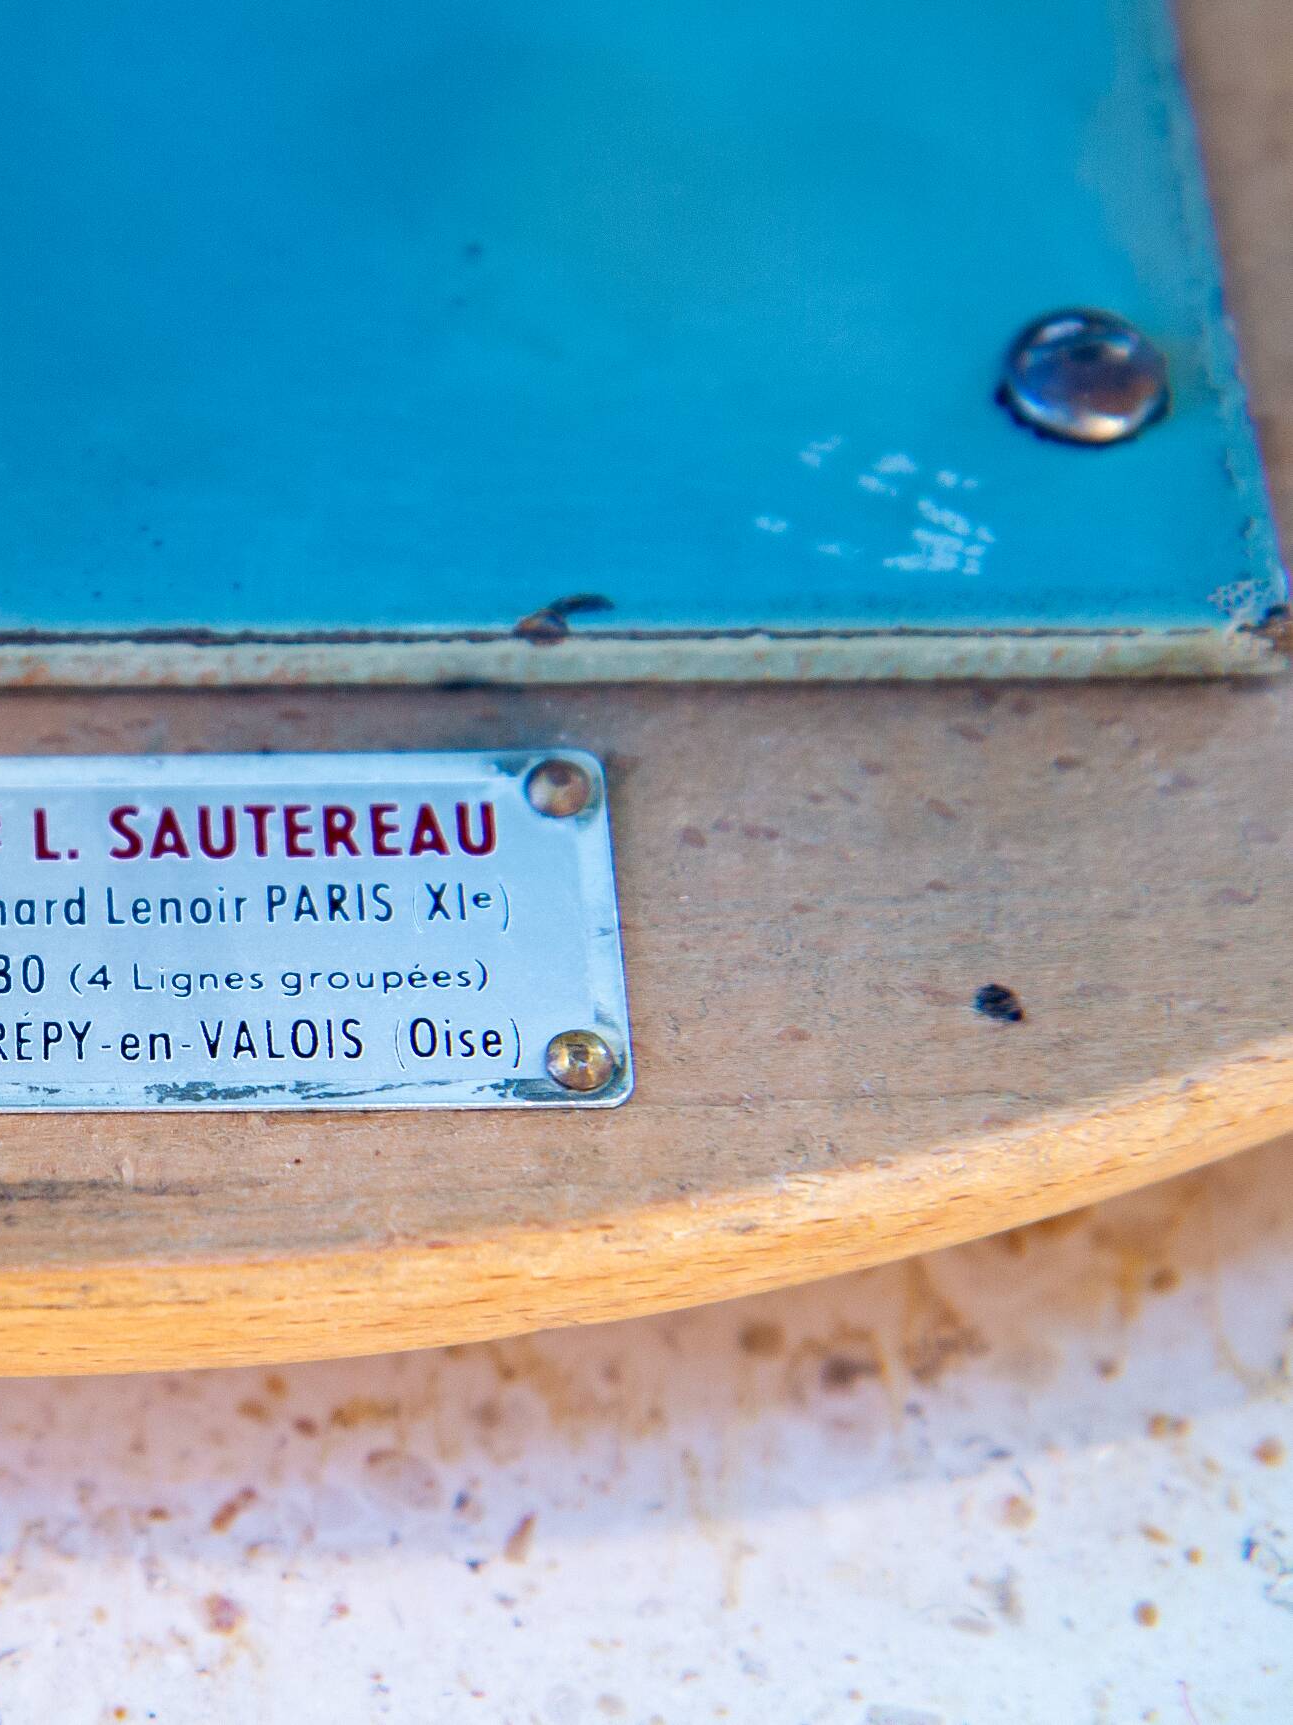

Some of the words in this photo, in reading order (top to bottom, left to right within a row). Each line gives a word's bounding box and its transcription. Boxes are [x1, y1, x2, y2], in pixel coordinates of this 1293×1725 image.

[34, 807, 80, 861] L.
[108, 801, 498, 861] SAUTEREAU
[106, 885, 248, 925] Lenoir
[266, 882, 394, 923] PARIS
[69, 961, 112, 996] (4
[132, 962, 264, 998] Lignes
[280, 958, 489, 997] groupées)
[394, 1018, 522, 1070] (Oise)
